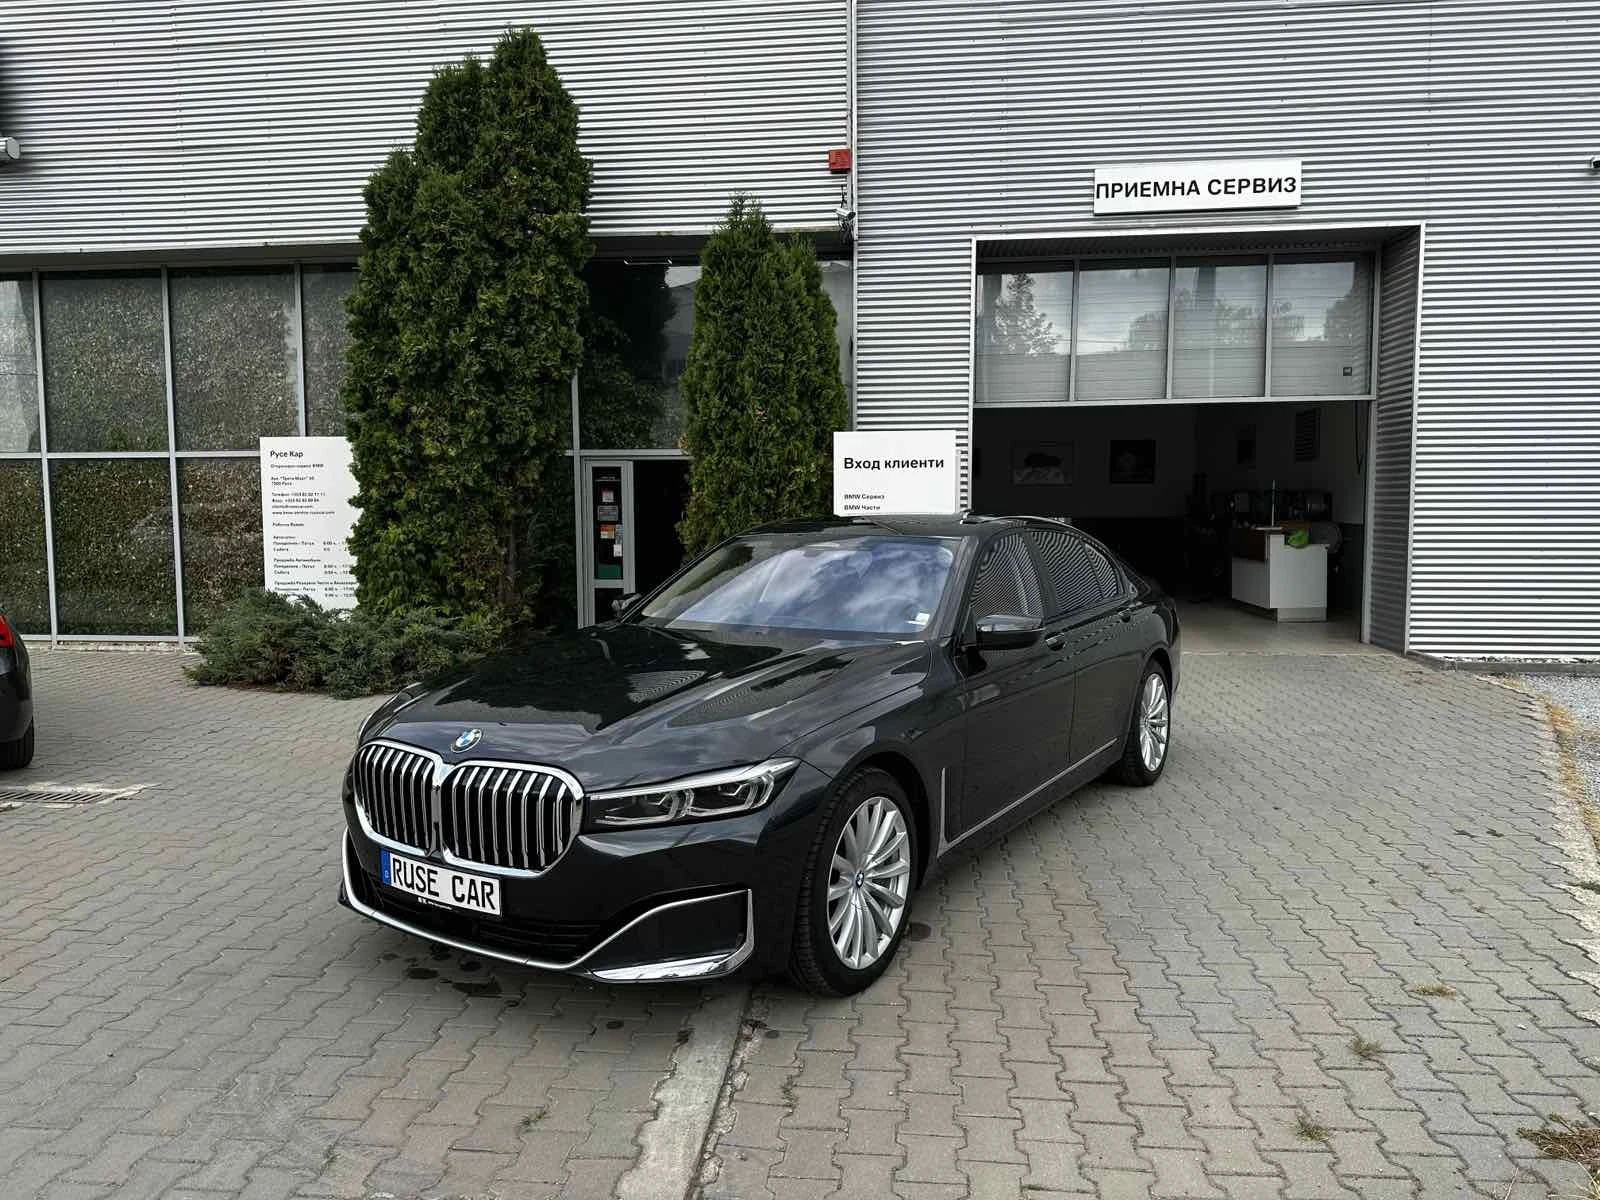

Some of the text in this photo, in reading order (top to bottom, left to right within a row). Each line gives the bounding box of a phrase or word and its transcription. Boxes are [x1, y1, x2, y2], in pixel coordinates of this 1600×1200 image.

[1096, 177, 1297, 199] ПРИЕМНА СЕРВИЗ
[270, 450, 304, 459] Русе Кар
[844, 457, 944, 470] Вход клиенти
[392, 857, 496, 910] RUSE CAR
